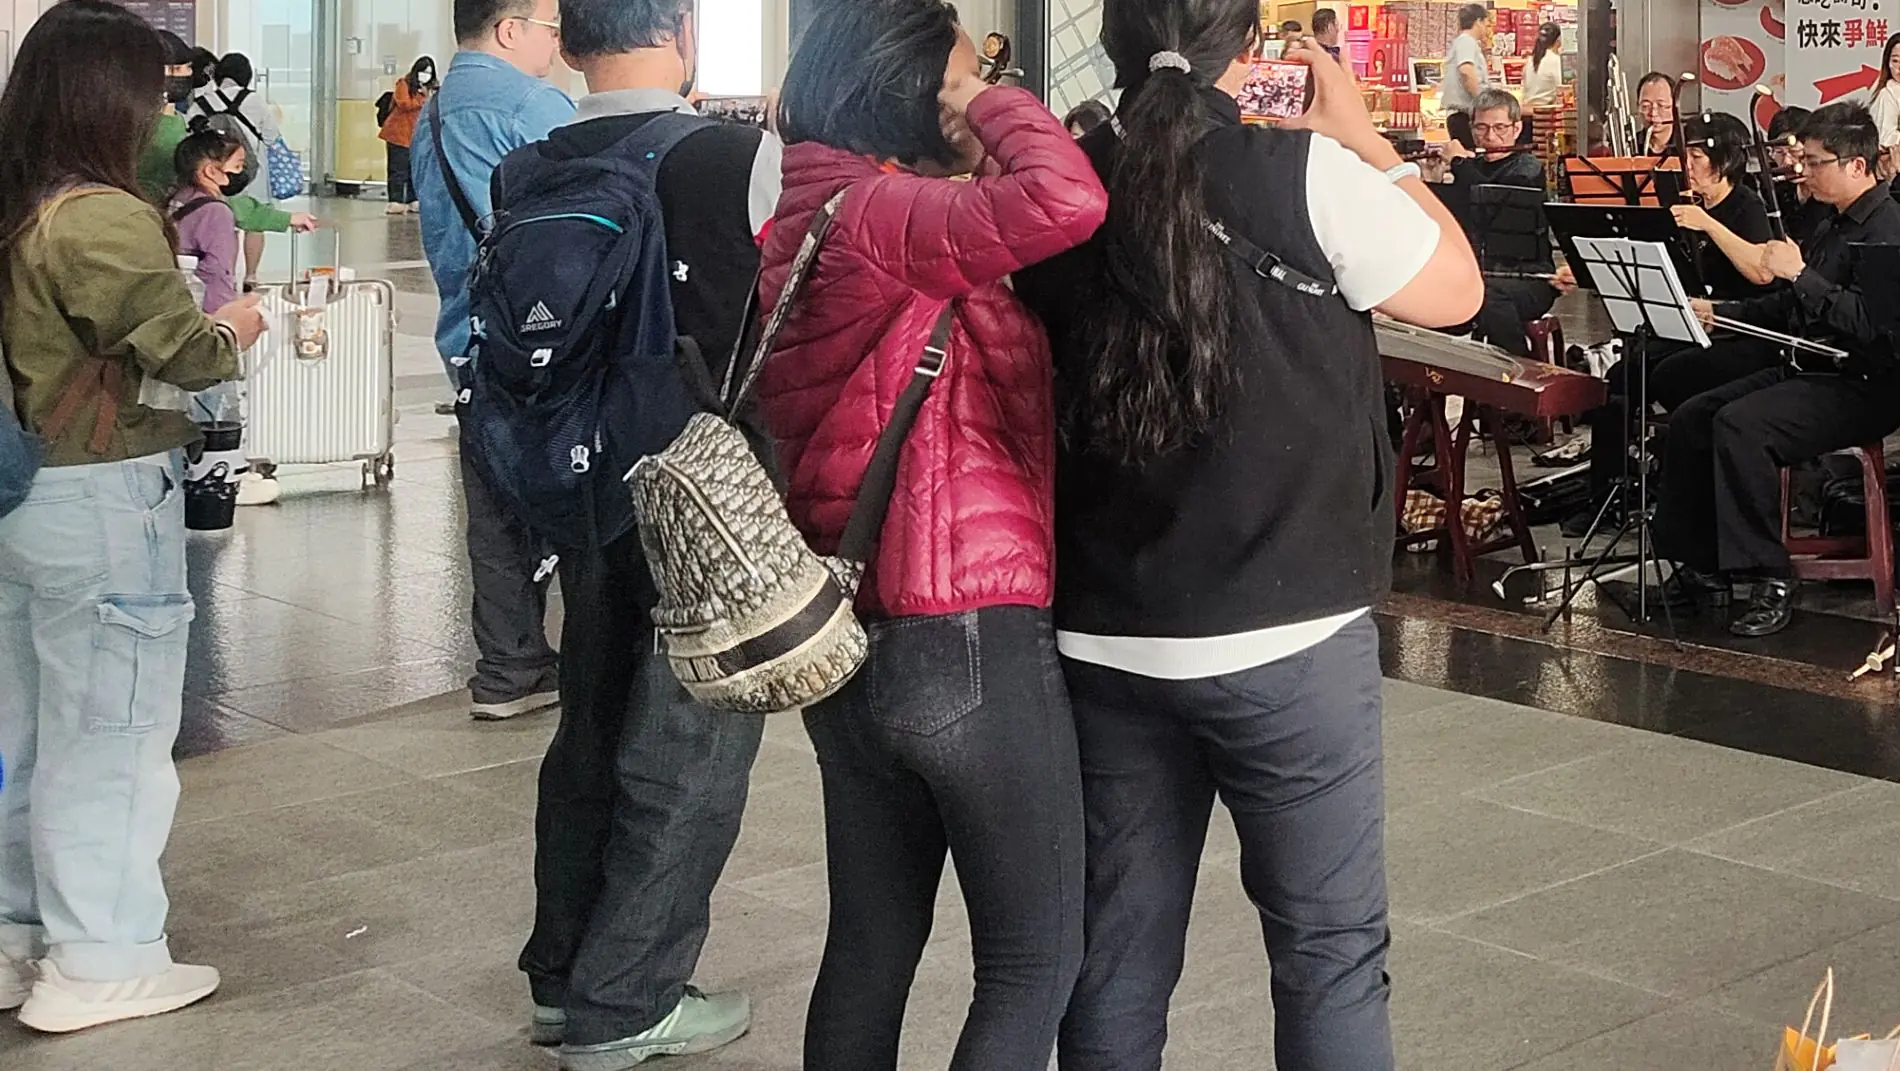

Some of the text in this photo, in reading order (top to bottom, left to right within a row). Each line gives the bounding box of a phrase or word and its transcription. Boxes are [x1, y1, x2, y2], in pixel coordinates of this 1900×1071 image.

[1797, 18, 1888, 48] 快來爭鮮
[519, 319, 562, 333] GREGORY
